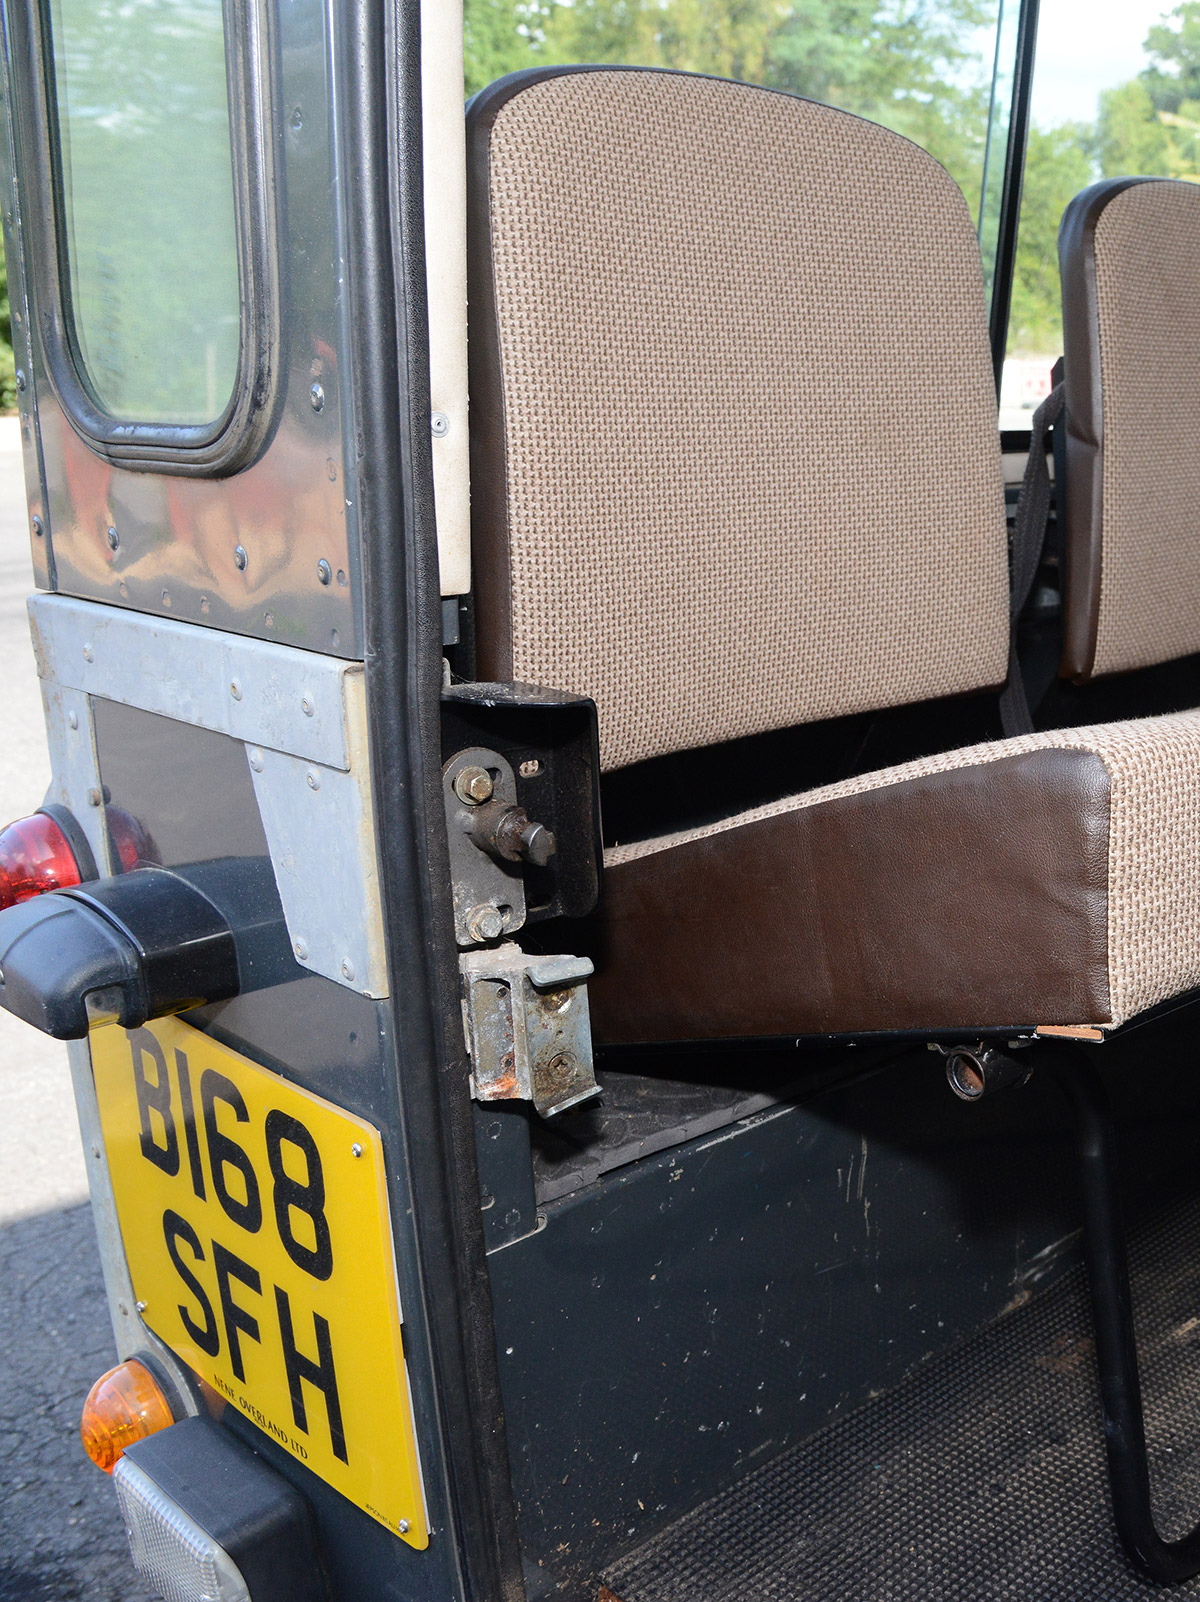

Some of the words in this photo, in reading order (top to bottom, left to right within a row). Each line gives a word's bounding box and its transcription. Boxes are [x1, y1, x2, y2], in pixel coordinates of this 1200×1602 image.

[125, 1026, 333, 1282] B168
[162, 1208, 349, 1467] SFH
[213, 1373, 236, 1401] NENE
[239, 1396, 288, 1444] OVERLAND
[291, 1438, 308, 1459] LTD
